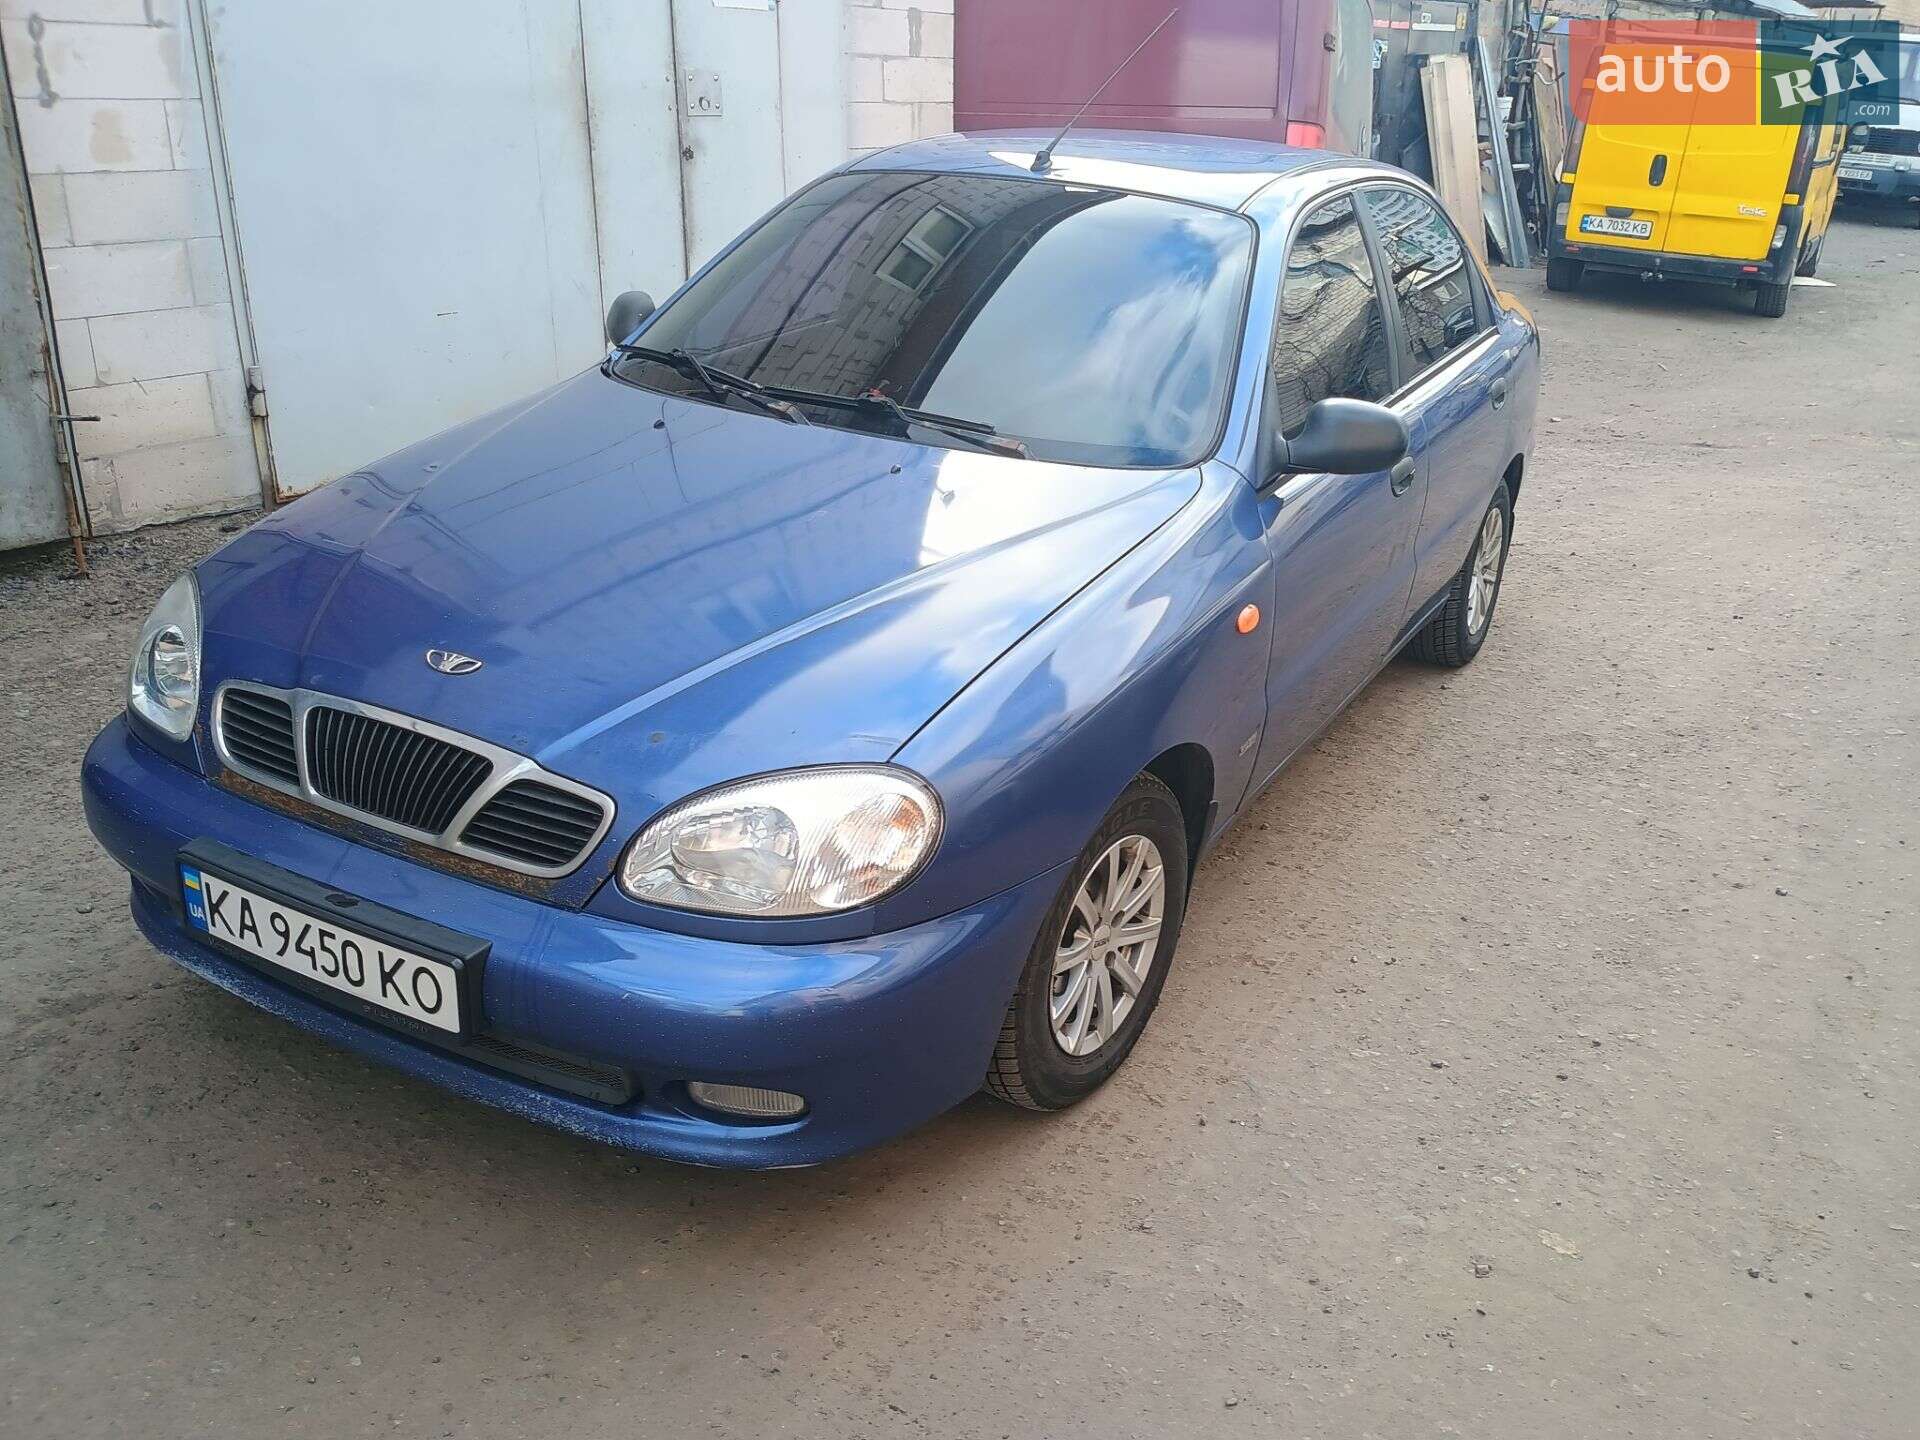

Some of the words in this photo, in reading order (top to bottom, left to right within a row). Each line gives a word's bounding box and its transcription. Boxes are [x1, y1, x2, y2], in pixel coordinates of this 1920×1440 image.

[1588, 217, 1604, 230] KA
[1607, 219, 1631, 232] 7032
[1632, 222, 1648, 234] KB
[190, 904, 205, 920] UA
[204, 881, 263, 948] KA
[269, 911, 366, 988] 9450
[377, 950, 443, 1015] KO
